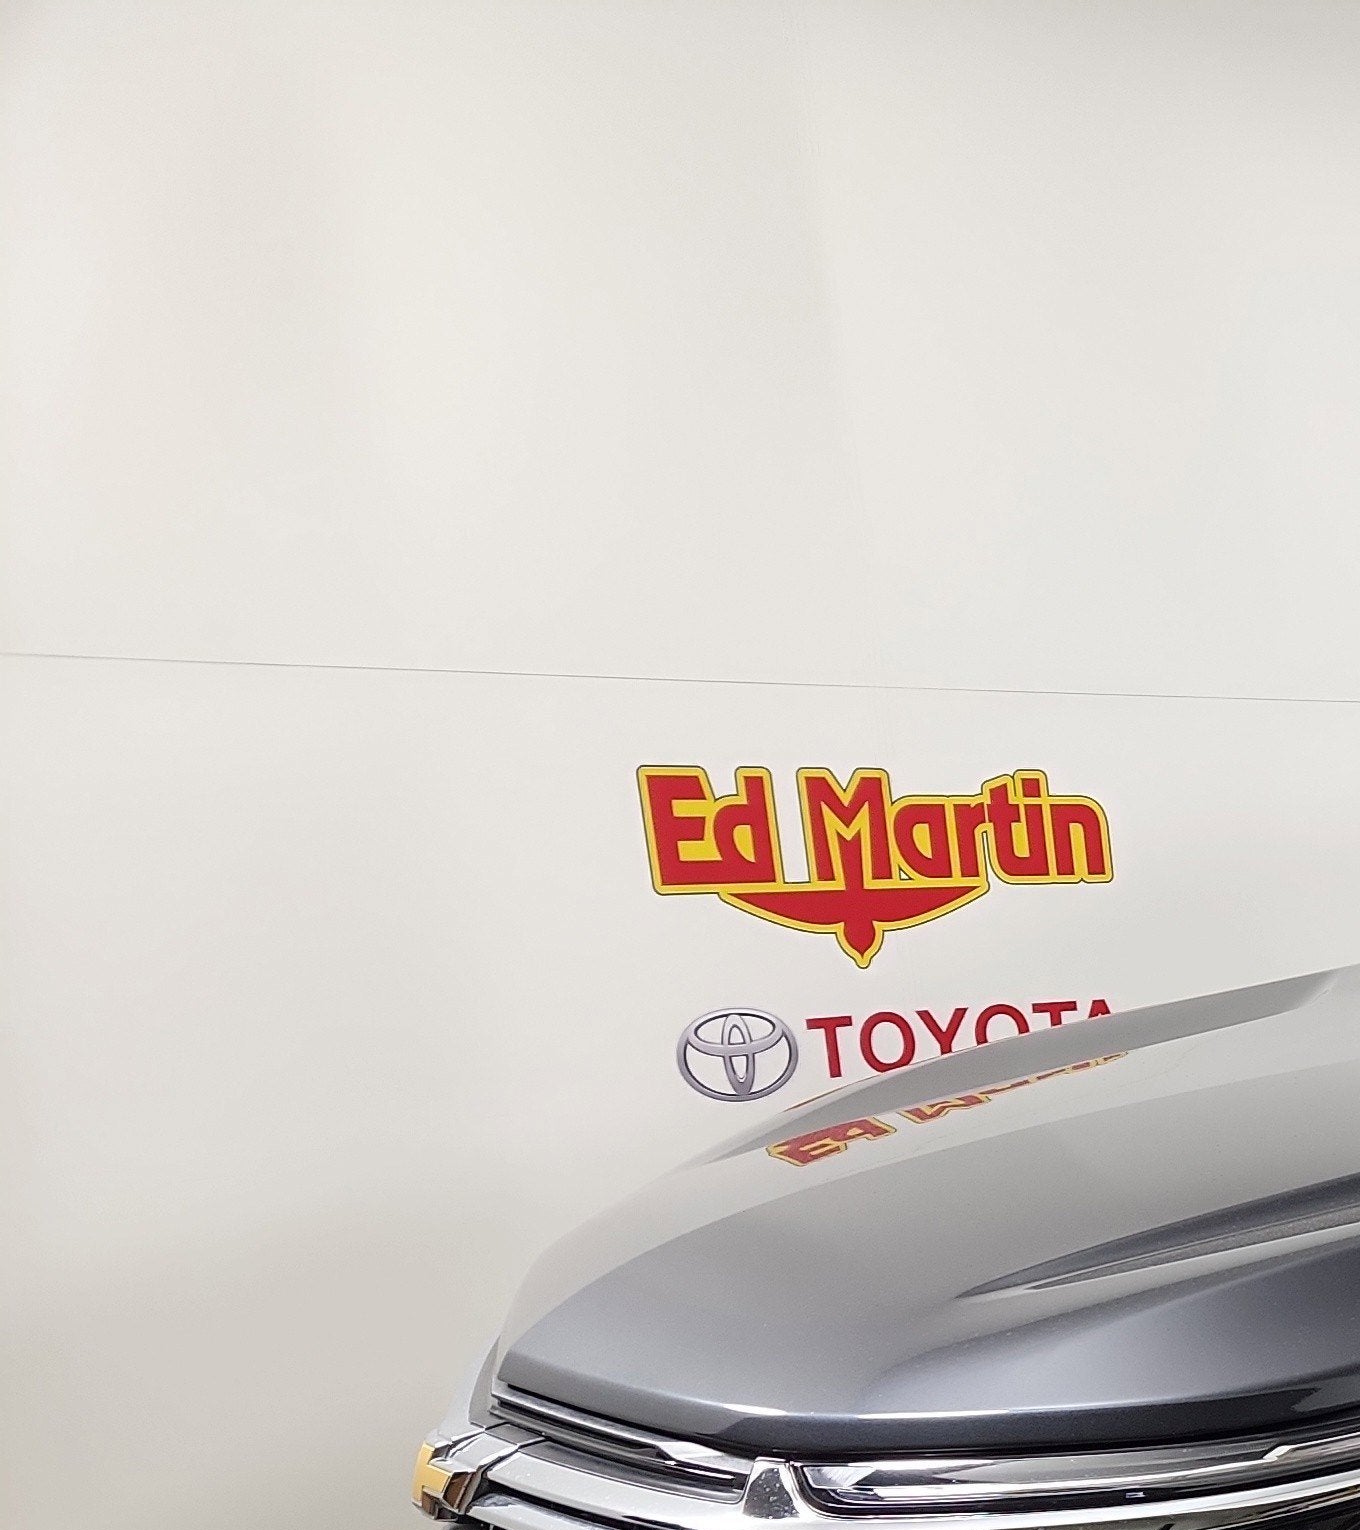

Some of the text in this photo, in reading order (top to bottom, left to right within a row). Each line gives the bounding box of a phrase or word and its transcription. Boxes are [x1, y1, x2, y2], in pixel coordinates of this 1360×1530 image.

[637, 766, 1113, 893] Ed Martin
[806, 998, 1112, 1079] TOYOT
